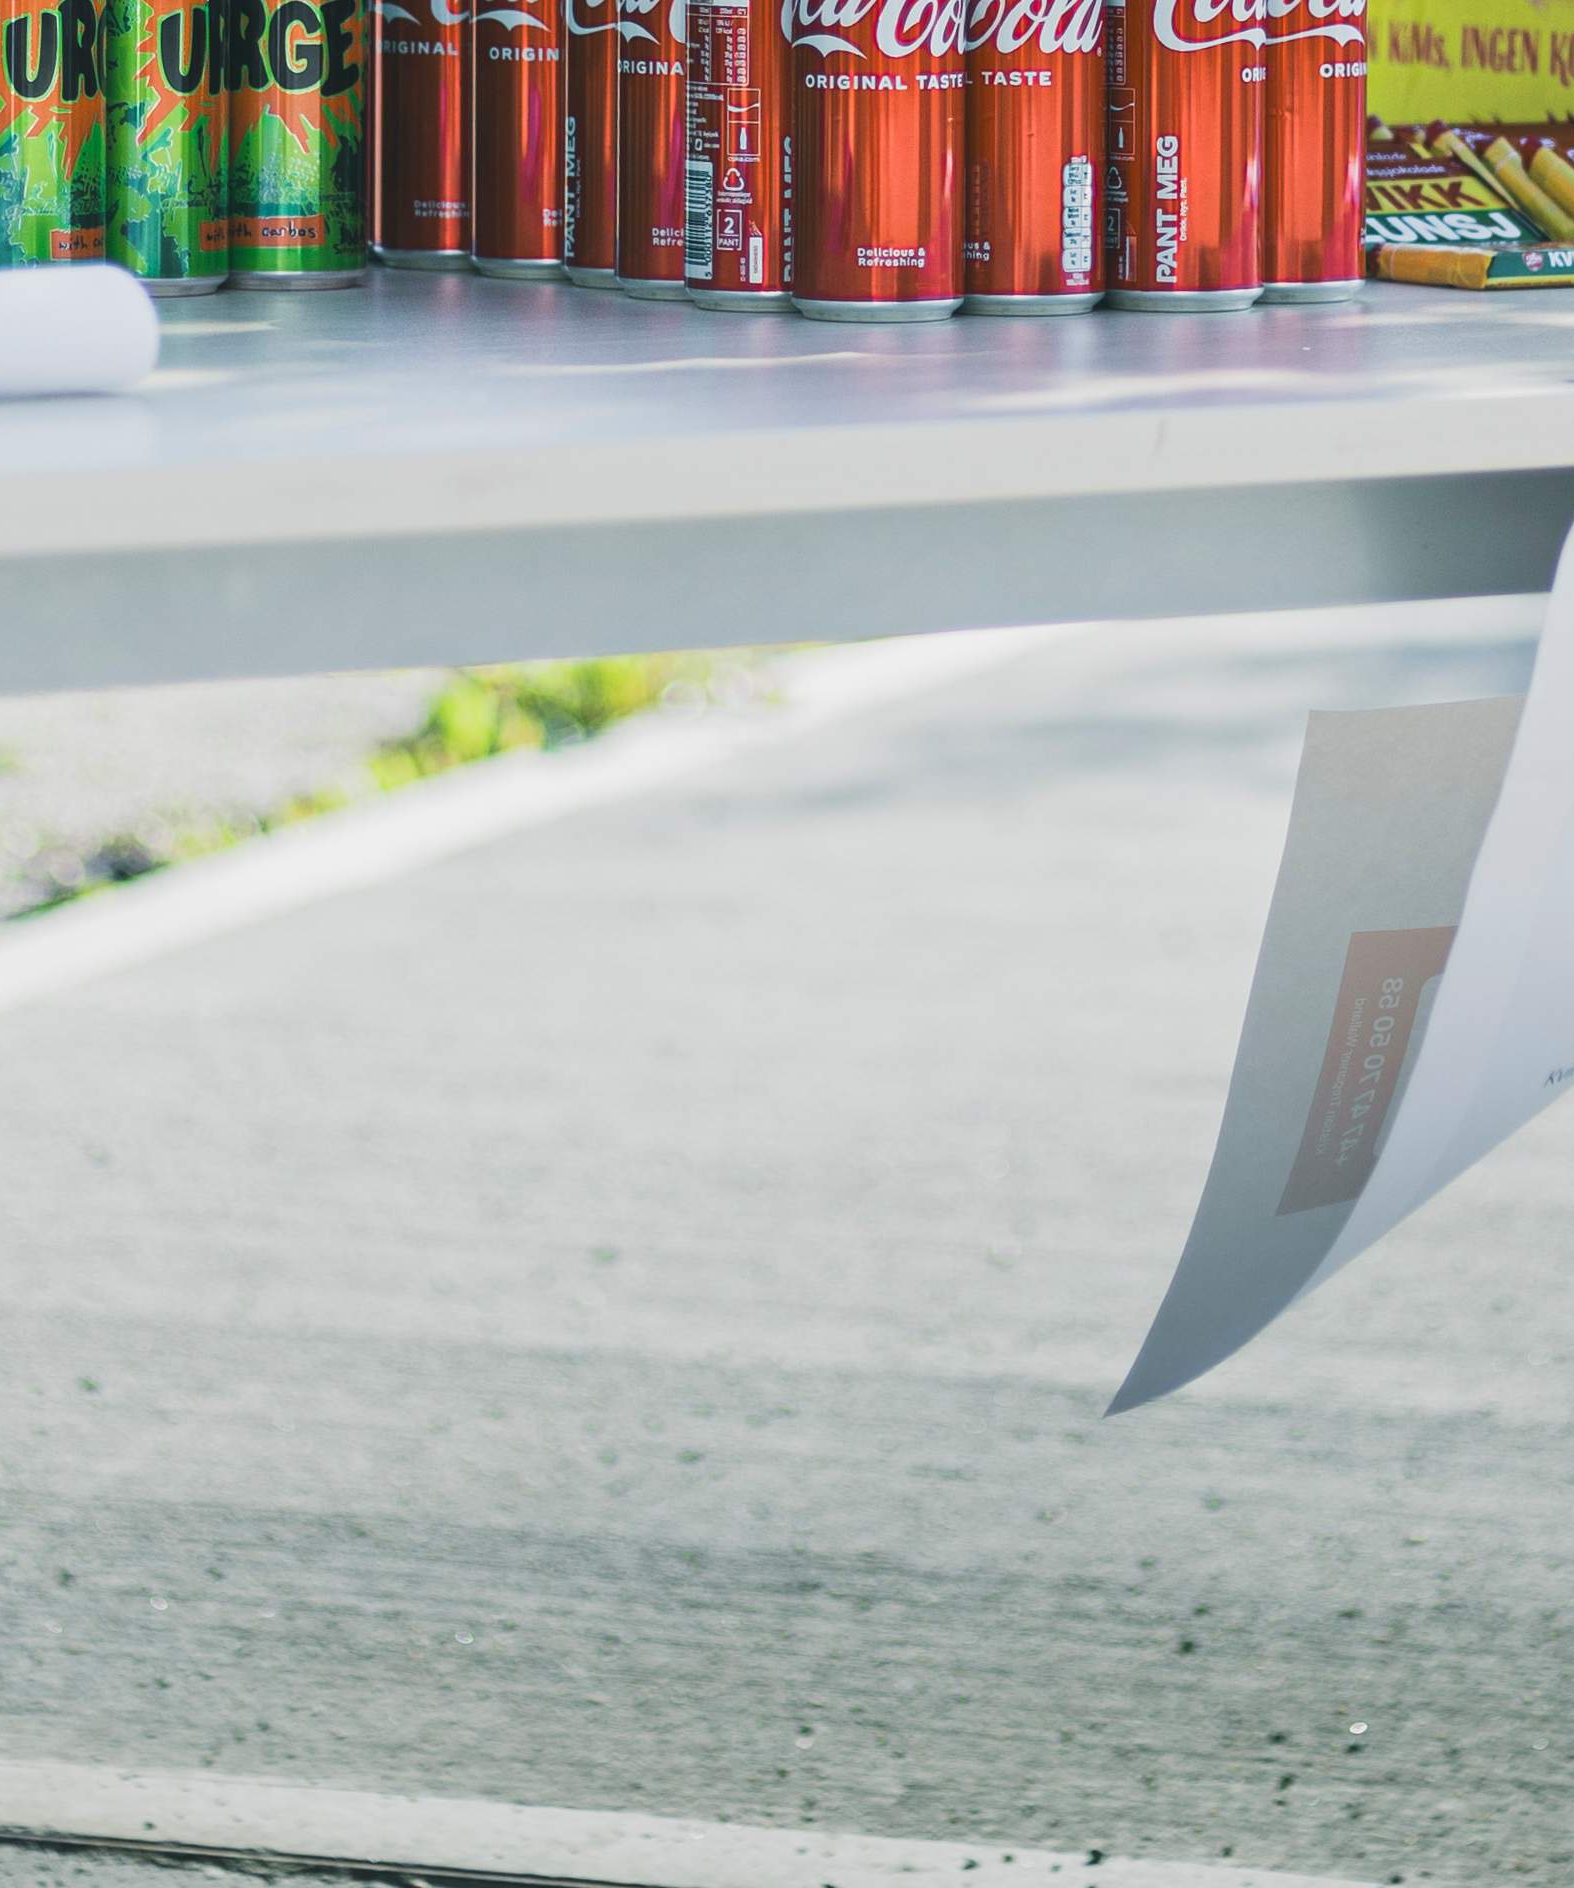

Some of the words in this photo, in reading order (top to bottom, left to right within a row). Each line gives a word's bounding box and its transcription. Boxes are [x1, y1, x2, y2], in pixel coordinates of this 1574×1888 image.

[489, 46, 560, 62] ORIGIN
[618, 60, 684, 76] ORIGINA
[805, 74, 908, 91] ORIGINAL
[915, 73, 964, 90] TASTE
[981, 71, 1052, 87] TASTE
[1156, 135, 1179, 200] MEG
[1366, 181, 1487, 211] VIKK
[415, 209, 469, 218] Refreshin
[651, 227, 684, 237] Delici
[724, 217, 735, 234] 2
[652, 237, 684, 247] Refre
[718, 237, 740, 247] PANT
[1156, 208, 1177, 284] PANT
[857, 247, 914, 257] Delicious
[917, 247, 926, 257] &
[858, 257, 926, 269] Refreshing
